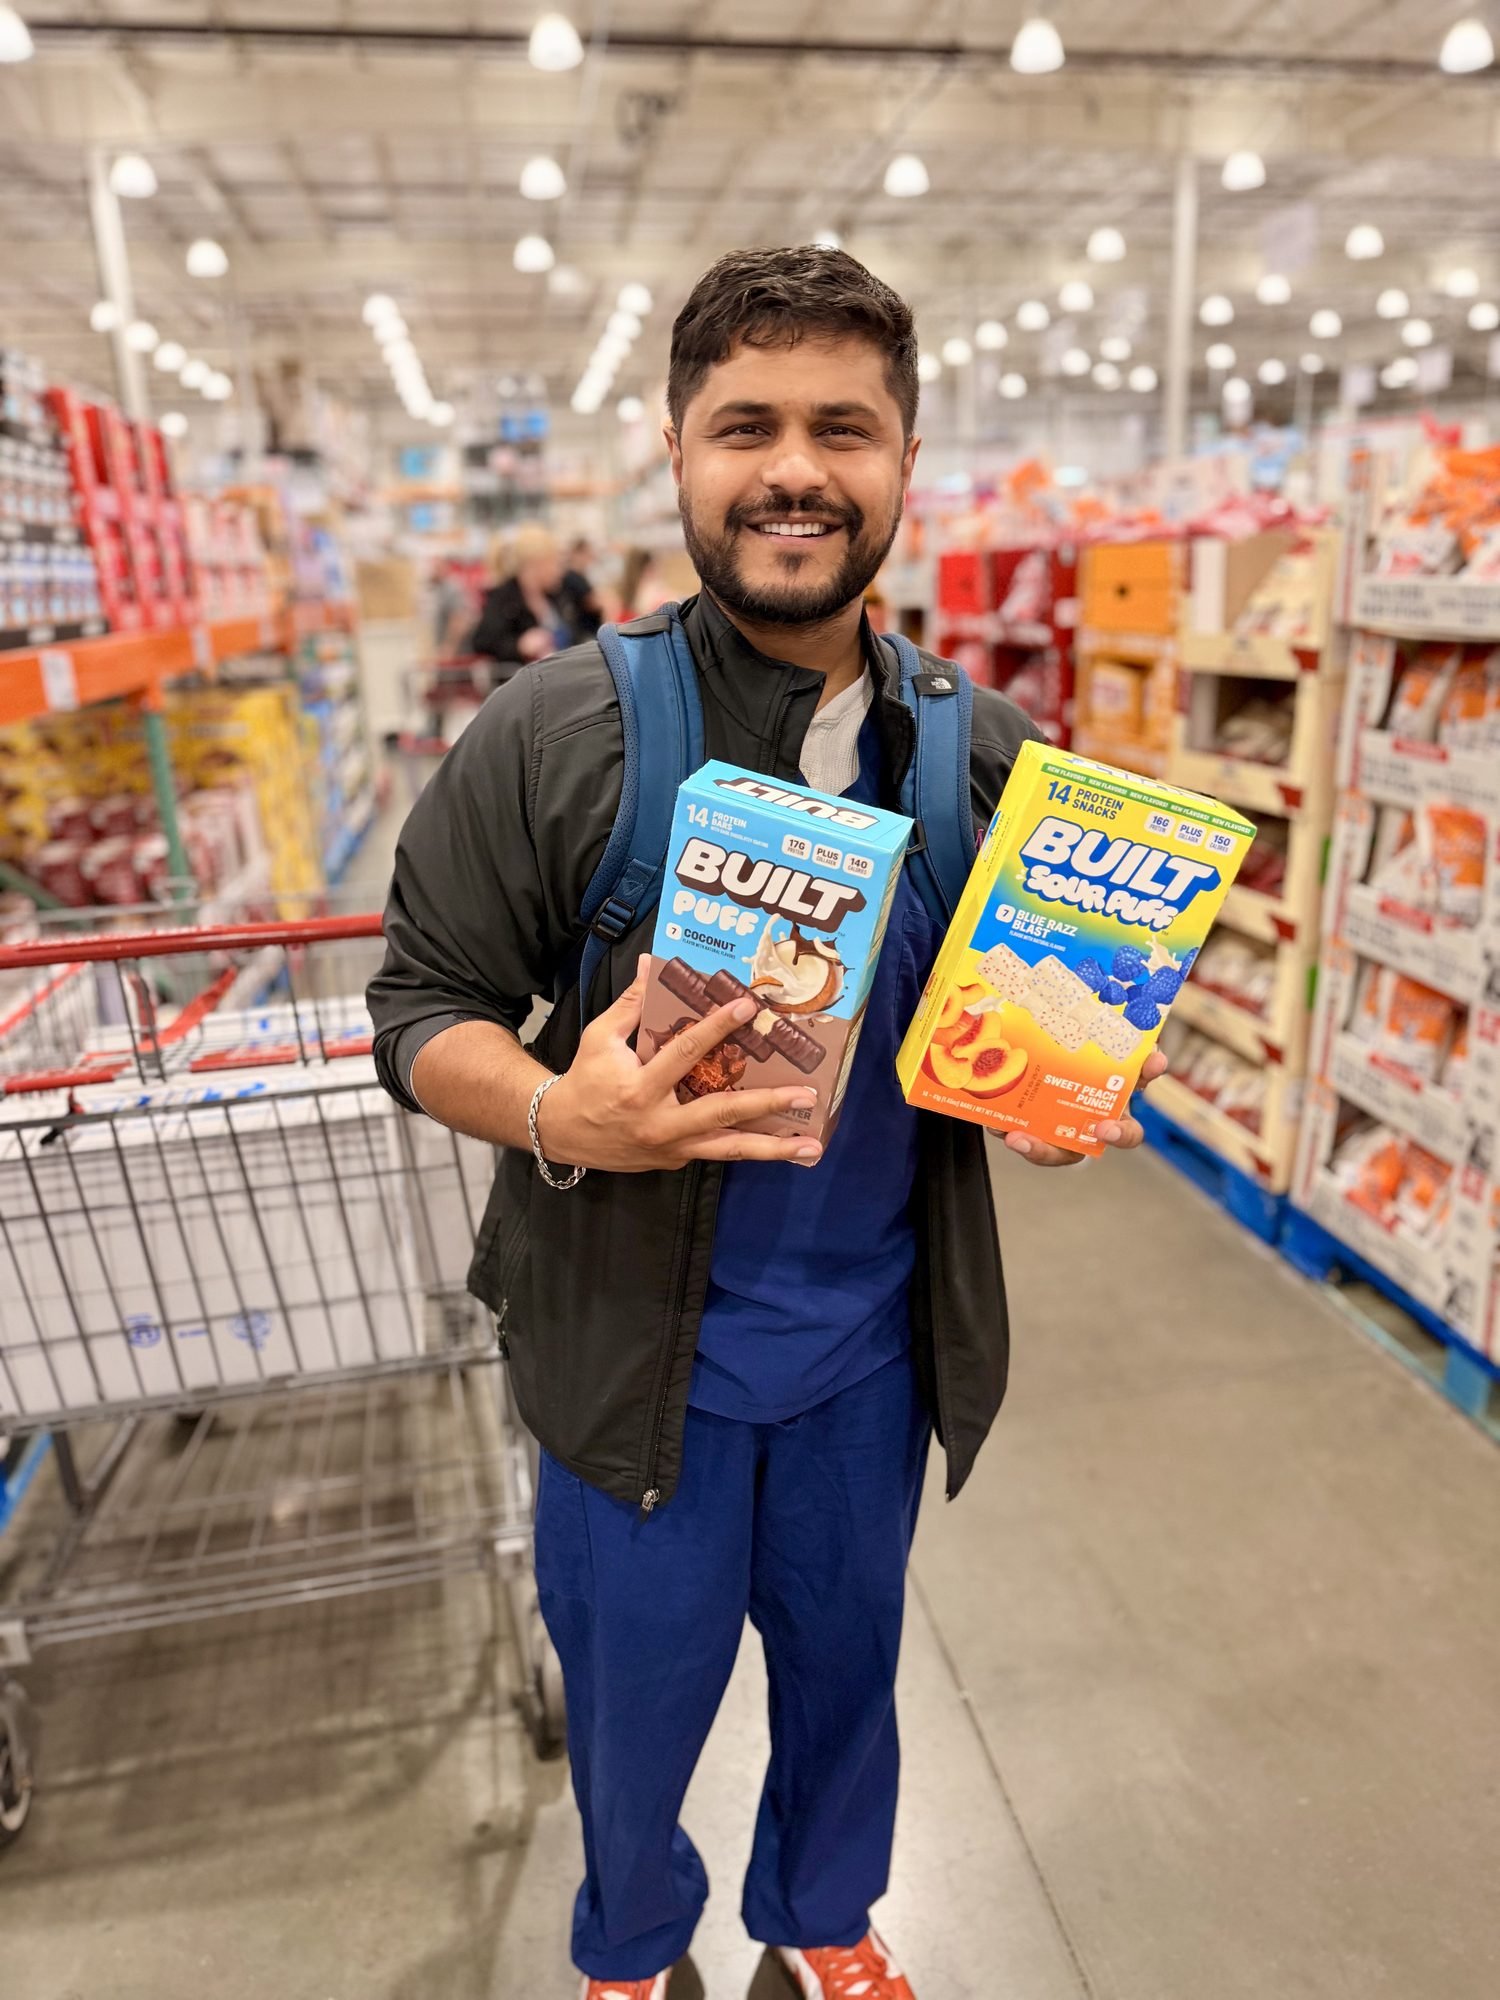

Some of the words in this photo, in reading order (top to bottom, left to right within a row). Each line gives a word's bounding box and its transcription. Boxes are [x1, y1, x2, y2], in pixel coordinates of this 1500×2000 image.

[713, 777, 880, 830] BUILT
[1047, 765, 1060, 774] NEW
[1088, 778, 1102, 787] NEW
[1130, 791, 1143, 800] NEW
[1170, 804, 1183, 813] NEW
[1212, 818, 1225, 826] NEW
[1048, 781, 1072, 804] 14
[1076, 788, 1124, 810] PROTEIN
[687, 804, 708, 828] 14
[712, 811, 748, 828] PROTEIN
[1072, 798, 1118, 820] SNACKS
[712, 820, 733, 831] BARS
[1152, 816, 1170, 827] 16G
[1180, 824, 1203, 837] PLUS
[789, 839, 806, 850] 17G
[1214, 835, 1231, 846] 150
[817, 848, 839, 860] PLUS
[850, 858, 868, 868] 140
[1020, 816, 1220, 903] BUILT
[675, 837, 865, 929] BUILT
[1023, 865, 1107, 912] SOUR
[1105, 890, 1180, 931] PUFF
[673, 890, 759, 936] PUFF
[1016, 910, 1047, 927] BLUE
[1047, 920, 1078, 937] RAZZ
[671, 927, 677, 935] 7
[684, 929, 736, 952] COCONUT
[1012, 920, 1051, 938] BLAST
[1044, 1074, 1082, 1092] SWEET
[1080, 1085, 1119, 1102] PEACH
[1112, 1079, 1119, 1087] 7
[1076, 1094, 1114, 1111] PUNCH
